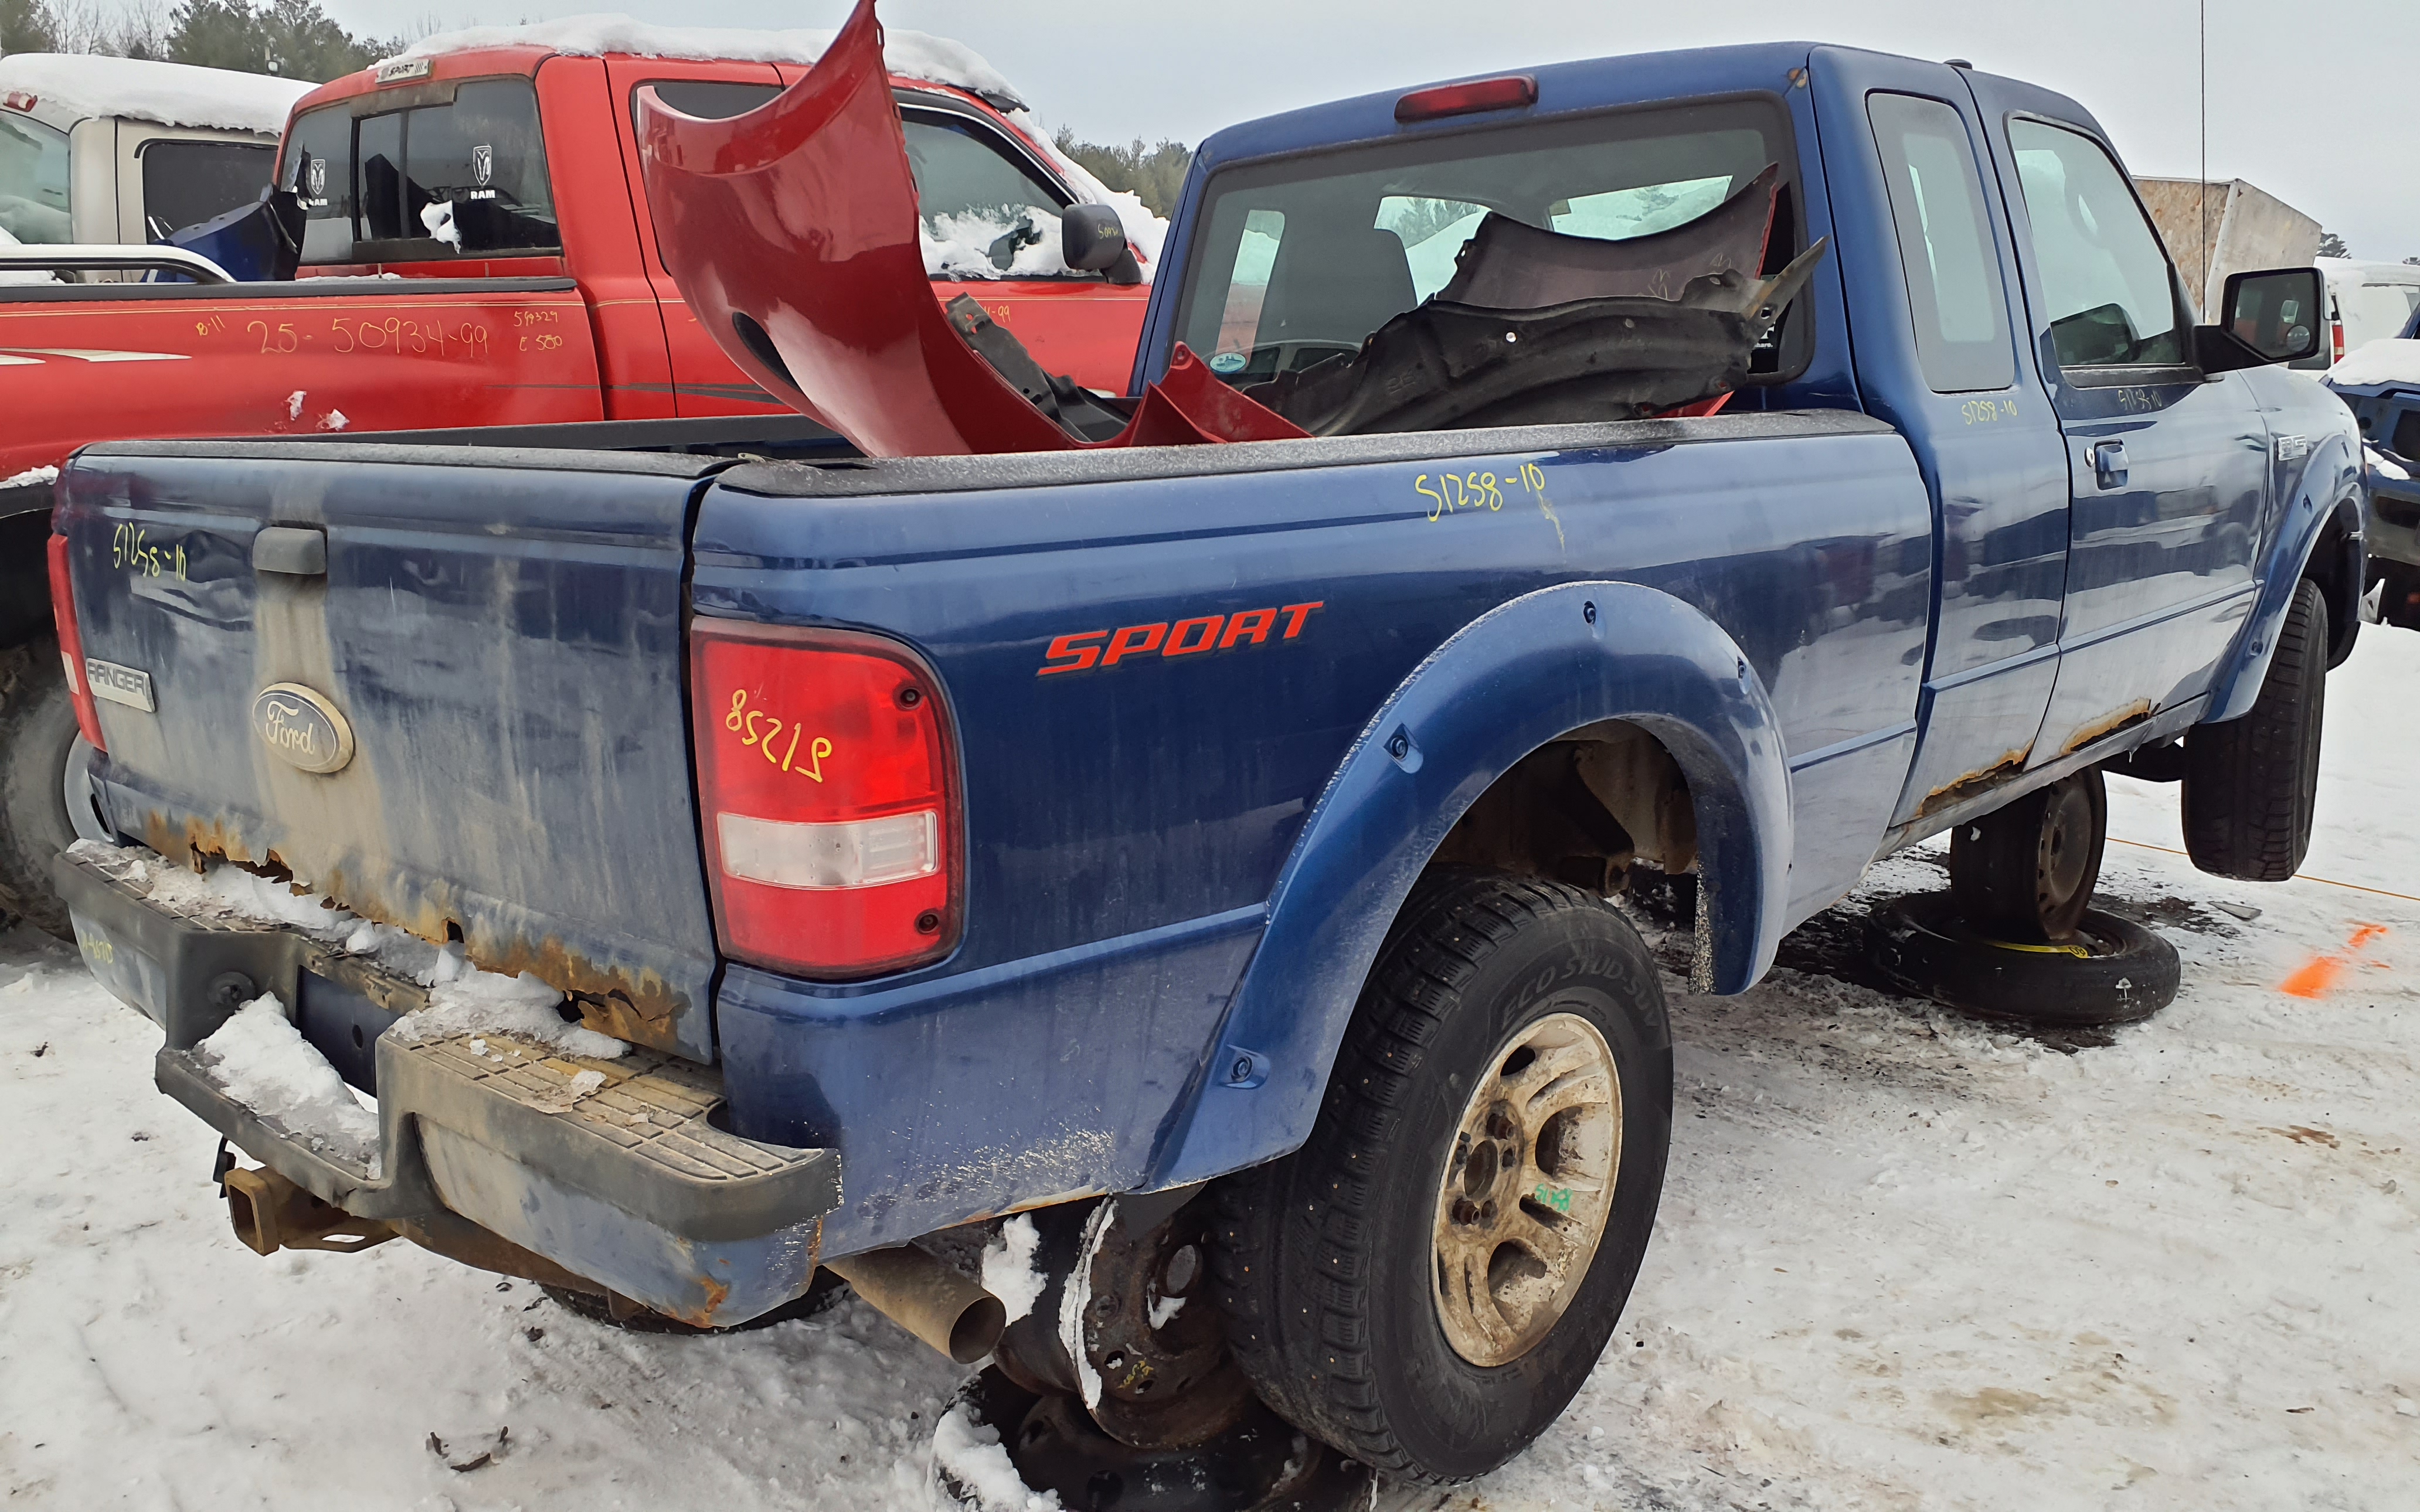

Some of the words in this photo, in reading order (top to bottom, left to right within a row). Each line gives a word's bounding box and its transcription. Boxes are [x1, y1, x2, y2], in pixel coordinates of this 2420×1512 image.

[470, 189, 495, 200] RAM
[1035, 600, 1325, 677] SPORT
[87, 661, 146, 696] RANGER
[265, 700, 315, 755] Ford
[1500, 965, 1557, 1031] ECO
